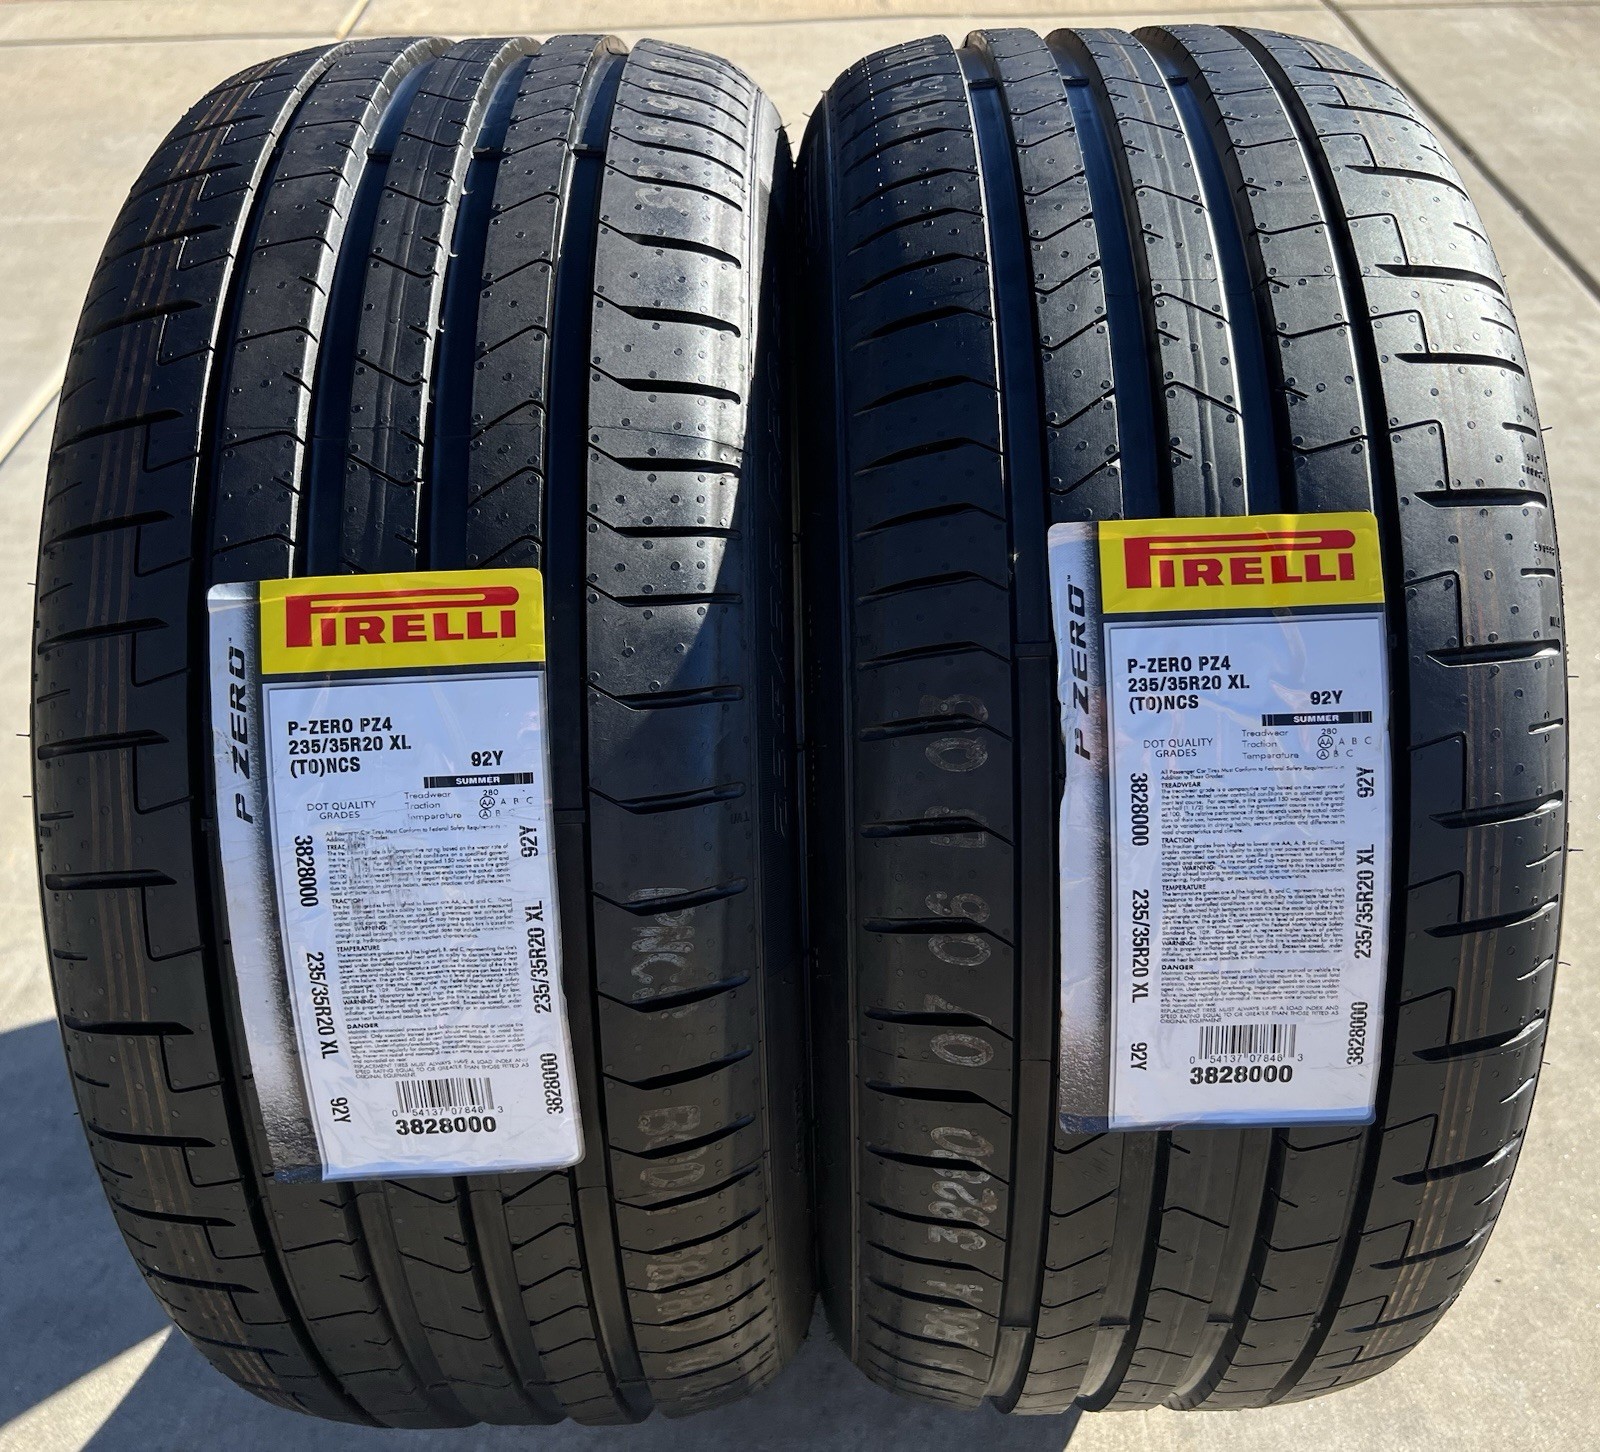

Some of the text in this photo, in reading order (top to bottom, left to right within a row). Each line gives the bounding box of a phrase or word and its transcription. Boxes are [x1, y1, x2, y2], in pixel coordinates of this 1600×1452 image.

[1124, 529, 1356, 589] PIRELLI
[286, 586, 520, 648] PIRELLI
[1127, 655, 1231, 673] P-ZERO PZ4
[1128, 674, 1250, 692] 235/35R20 XL
[1310, 690, 1343, 705] 92Y
[288, 717, 393, 736] P-ZERO PZ4
[1293, 714, 1339, 723] SUMMER
[1242, 728, 1289, 737] Treadwear
[1242, 739, 1277, 748] Traction
[1364, 736, 1372, 744] C
[288, 734, 411, 755] 235/35R20 XL
[1074, 727, 1091, 761] P
[1143, 737, 1214, 749] DOT QUALITY
[471, 750, 504, 767] 92Y
[1155, 748, 1197, 758] GRADES
[1242, 751, 1299, 761] Temperature
[1346, 749, 1353, 757] C
[456, 776, 501, 786] SUMMER
[1356, 766, 1374, 798] 92Y
[403, 788, 499, 800] Treadwear 280
[404, 801, 441, 810] Traction
[526, 796, 533, 804] C
[235, 792, 254, 824] P
[306, 800, 376, 812] DOT QUALITY
[319, 811, 361, 820] GRADES
[1130, 772, 1149, 846] 3828000
[519, 825, 539, 858] 92Y
[294, 835, 319, 907] 3828000
[1354, 843, 1374, 959] 235/35R20 XL
[336, 944, 381, 952] TEMPERATURE
[1131, 889, 1150, 1003] 235/35R20 XL
[525, 901, 552, 1013] 235/35R20 XL
[305, 951, 339, 1059] 235/35R20 XL
[346, 1022, 379, 1030] DANGER
[1346, 1001, 1368, 1065] 3828000
[1130, 1041, 1148, 1071] 92Y
[1189, 1053, 1304, 1064] 0 54137 07846 3
[541, 1053, 563, 1115] 3828000
[1189, 1065, 1293, 1085] 3828000
[330, 1096, 352, 1123] 92Y
[392, 1109, 398, 1117] 0
[412, 1107, 444, 1117] 54137
[498, 1105, 504, 1114] 3
[395, 1115, 497, 1135] 3828000
